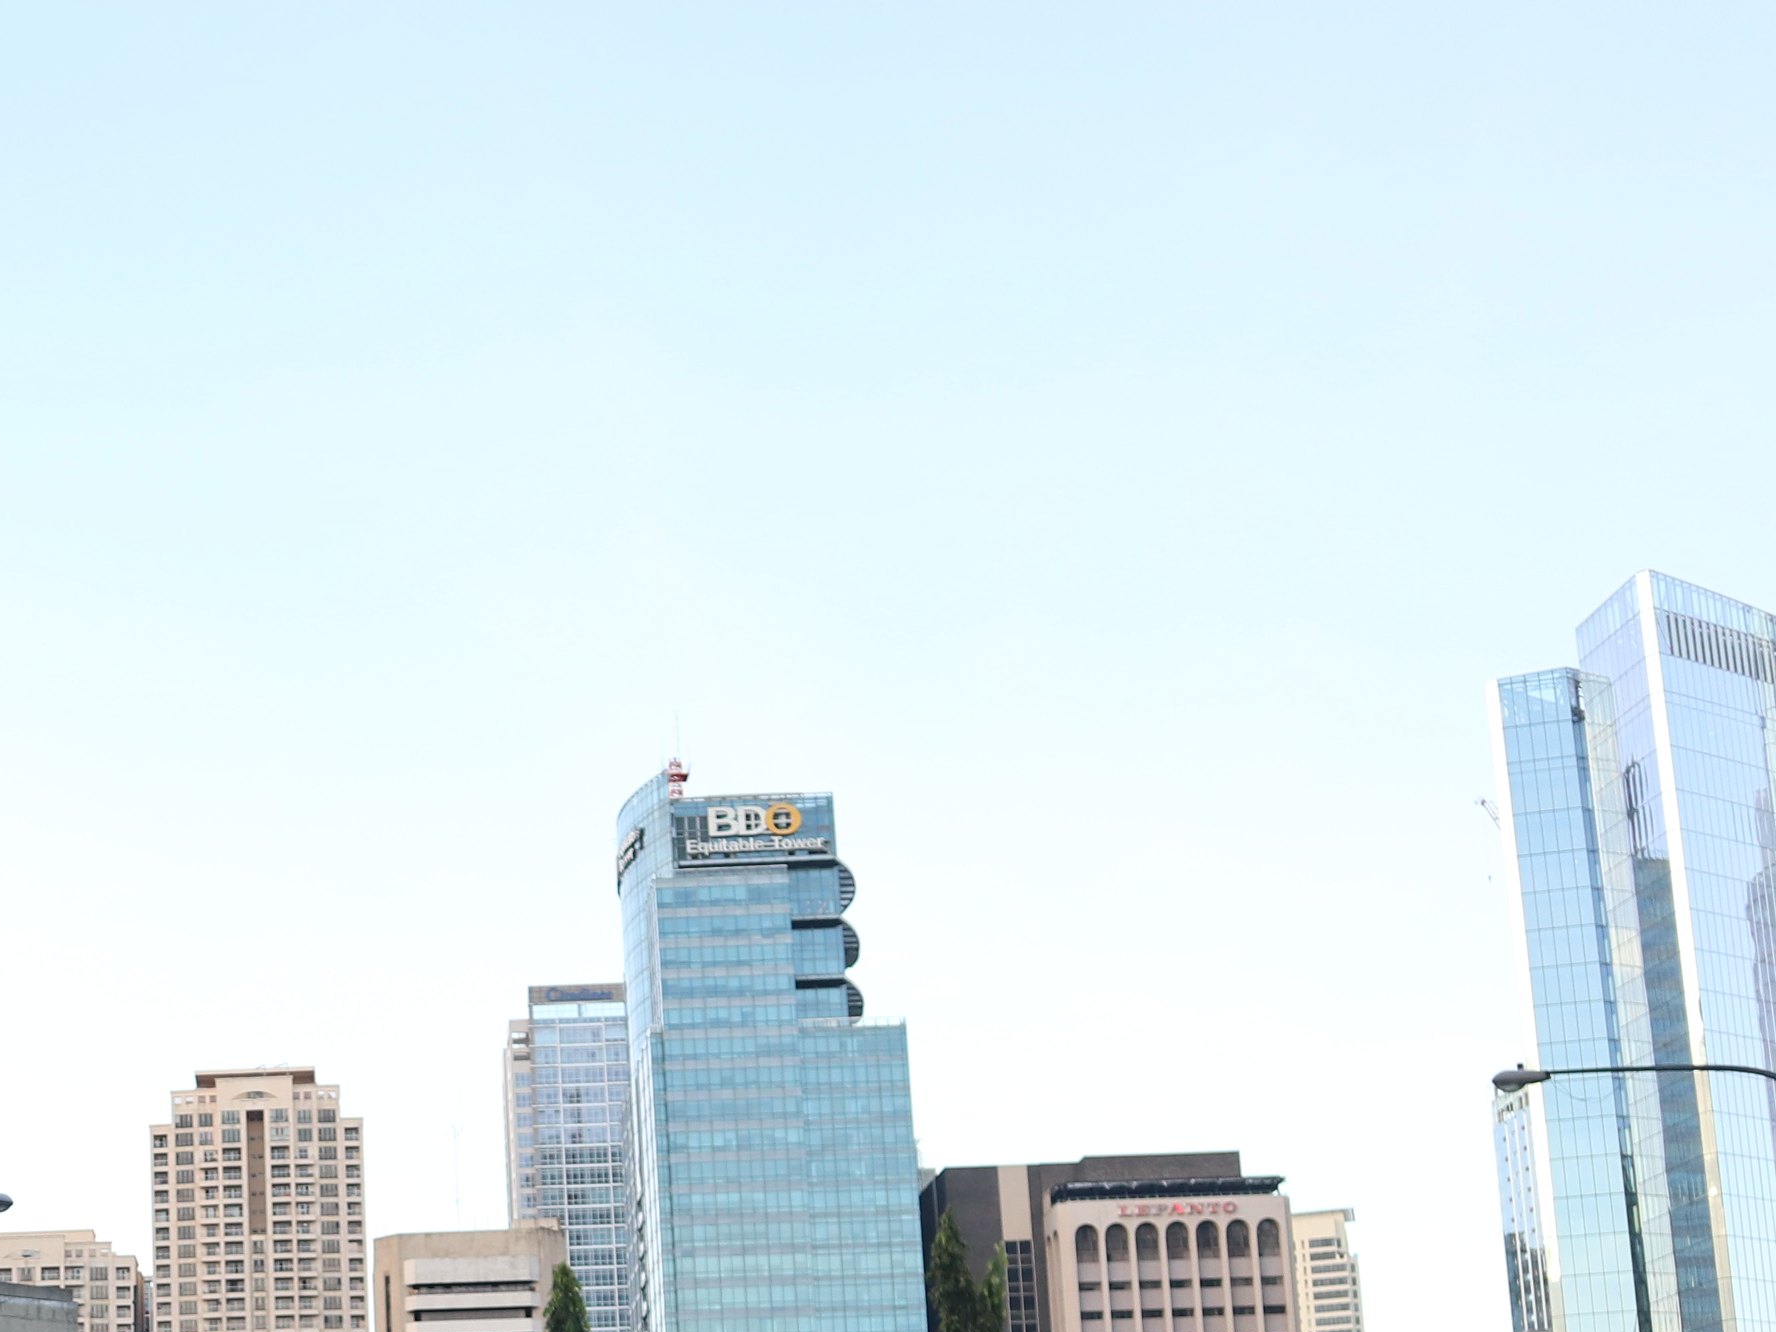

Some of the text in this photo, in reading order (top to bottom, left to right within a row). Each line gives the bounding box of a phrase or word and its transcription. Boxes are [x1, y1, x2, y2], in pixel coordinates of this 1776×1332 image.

[707, 804, 801, 836] BDO
[686, 836, 825, 855] Equitable Tower
[1119, 1202, 1237, 1217] LEPANTO
